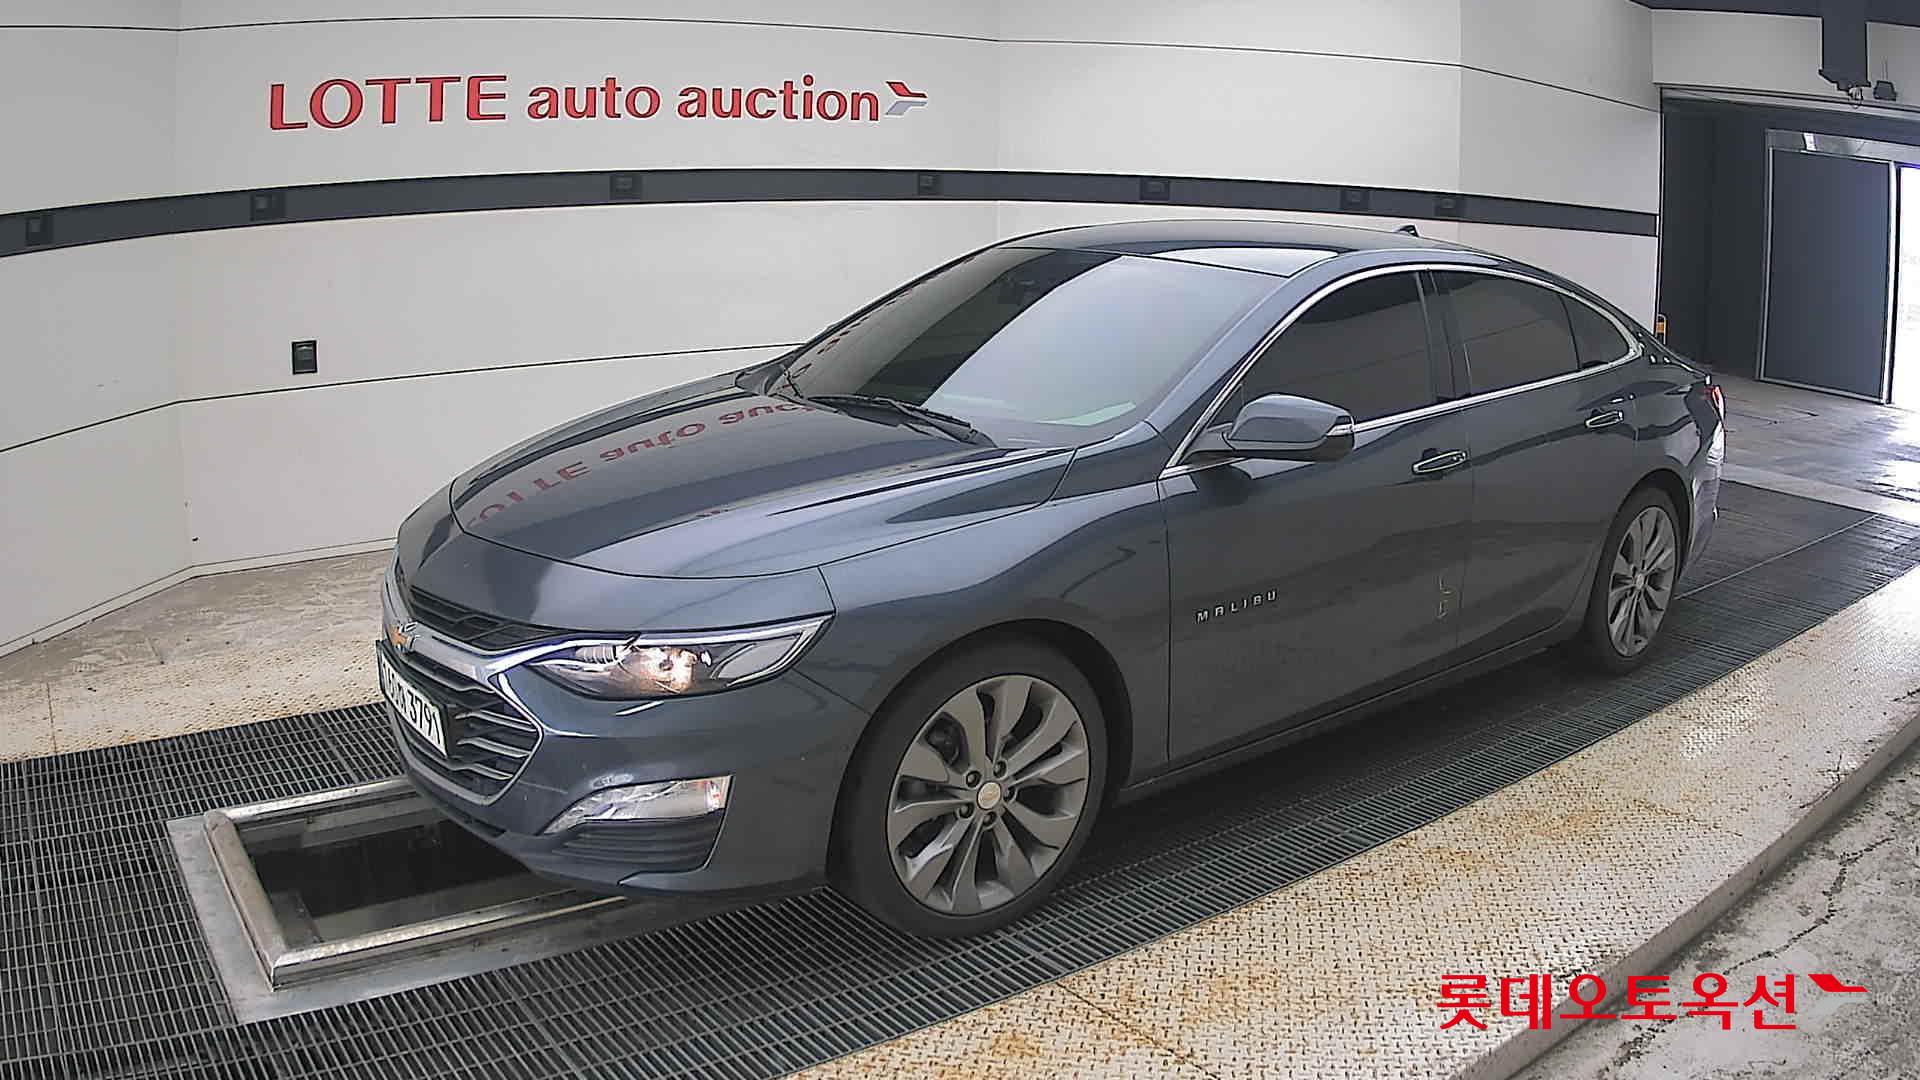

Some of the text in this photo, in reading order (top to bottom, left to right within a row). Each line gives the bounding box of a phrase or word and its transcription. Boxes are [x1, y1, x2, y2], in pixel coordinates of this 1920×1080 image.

[268, 73, 881, 131] LOTTE auto auction
[1195, 590, 1278, 624] MALIBU
